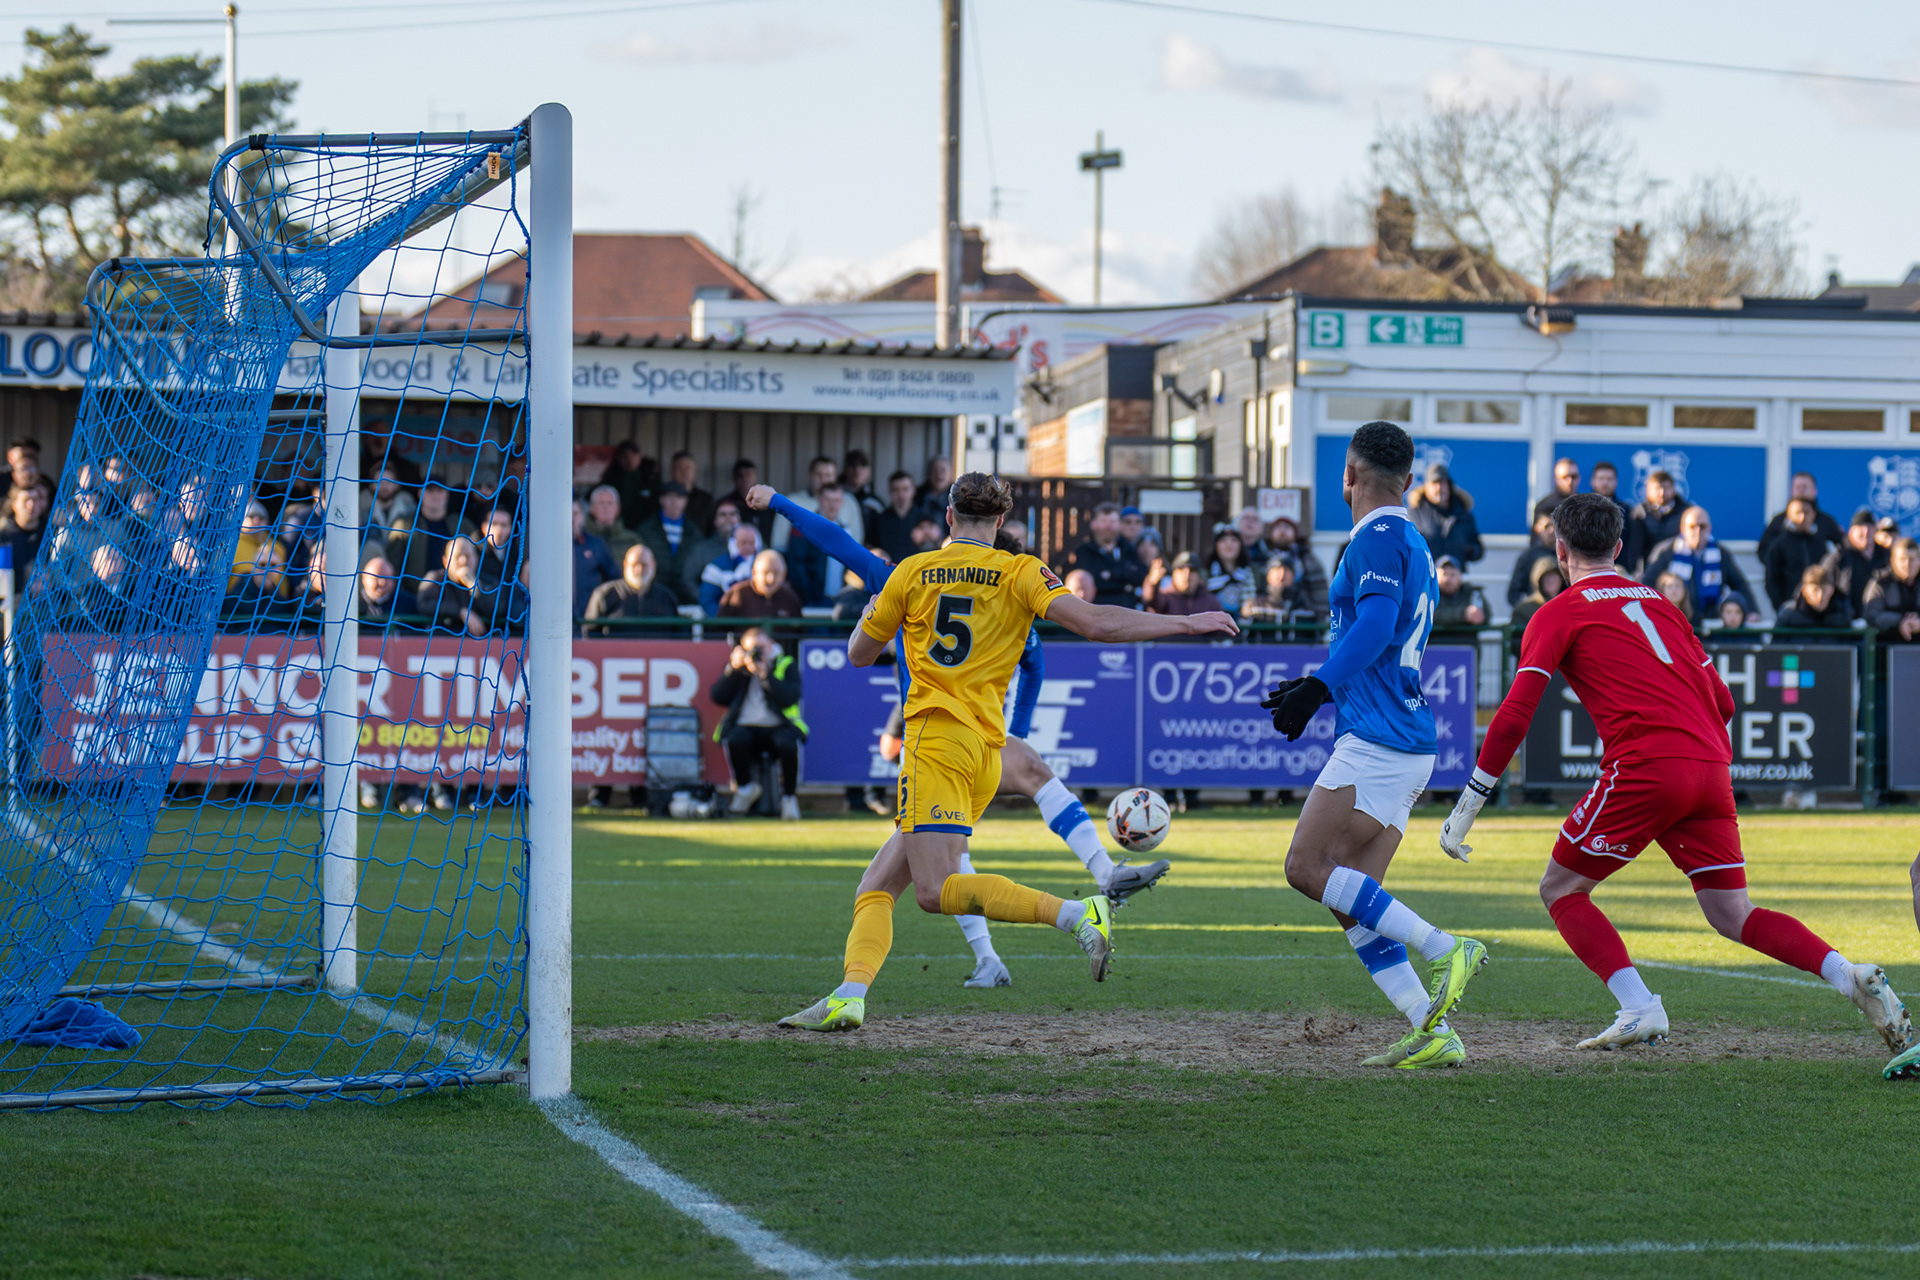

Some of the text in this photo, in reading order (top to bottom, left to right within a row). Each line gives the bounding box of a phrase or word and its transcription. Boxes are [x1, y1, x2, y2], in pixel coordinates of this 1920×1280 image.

[1313, 314, 1341, 346] B
[446, 354, 470, 383] &
[631, 361, 784, 397] Specialists
[1262, 492, 1295, 509] EXIT
[921, 566, 1001, 588] FERNANDEZ
[928, 593, 974, 667] 5
[1621, 600, 1673, 665] 1
